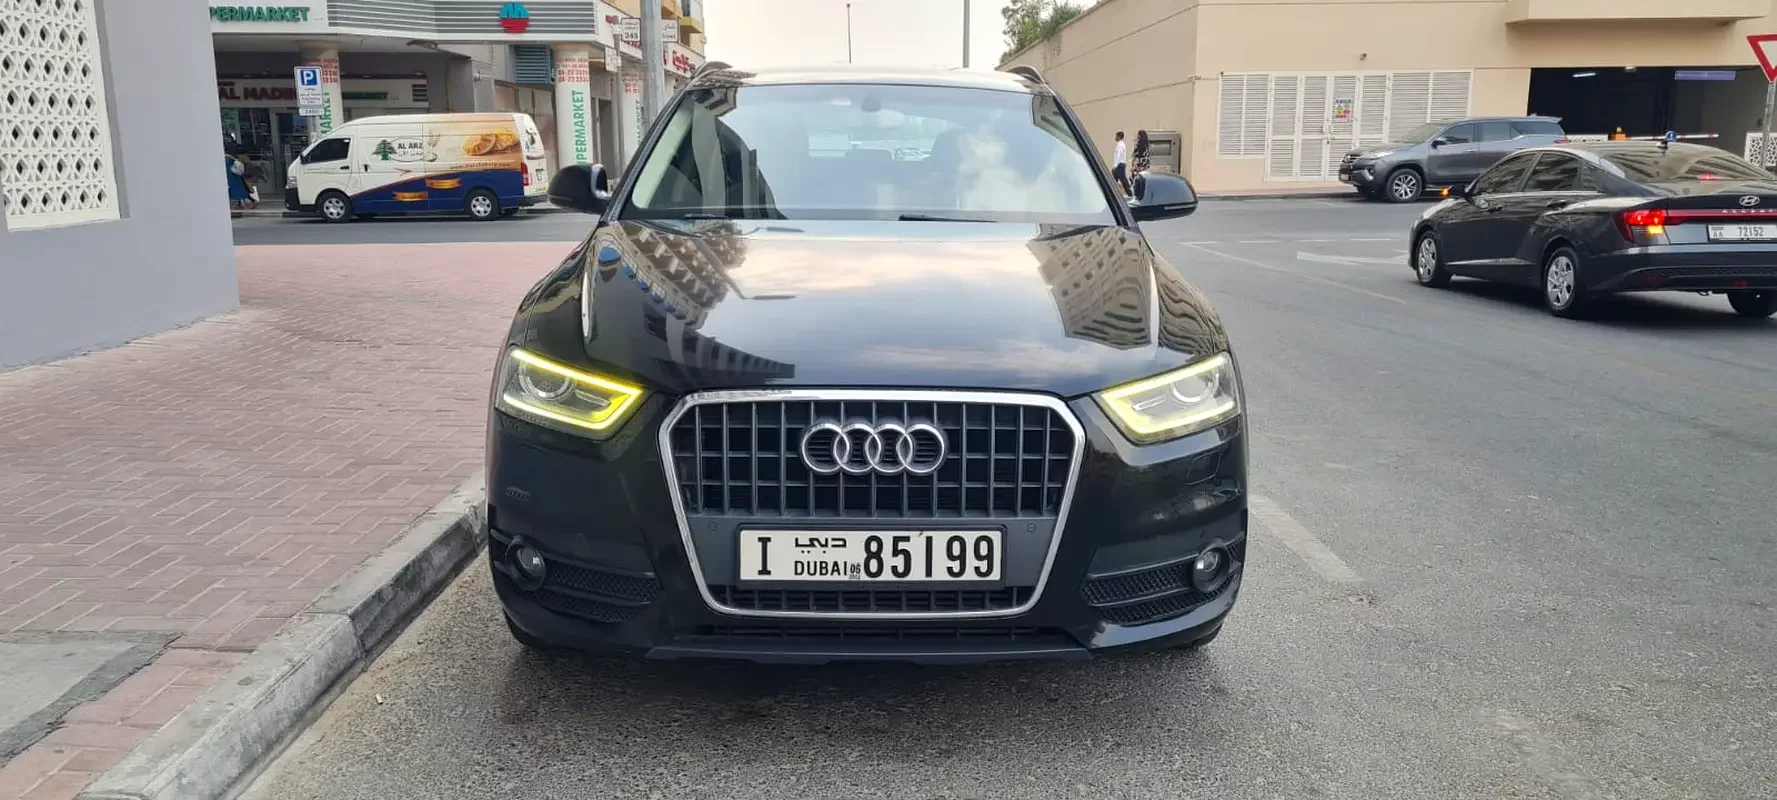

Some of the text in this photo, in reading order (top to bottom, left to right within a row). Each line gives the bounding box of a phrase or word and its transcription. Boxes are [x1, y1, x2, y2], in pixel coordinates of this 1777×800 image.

[210, 6, 310, 22] PERMARKET
[302, 70, 315, 85] P
[1738, 226, 1764, 237] 72152
[794, 537, 847, 554] دبي
[863, 535, 994, 578] 85199
[794, 561, 847, 576] DUBAI
